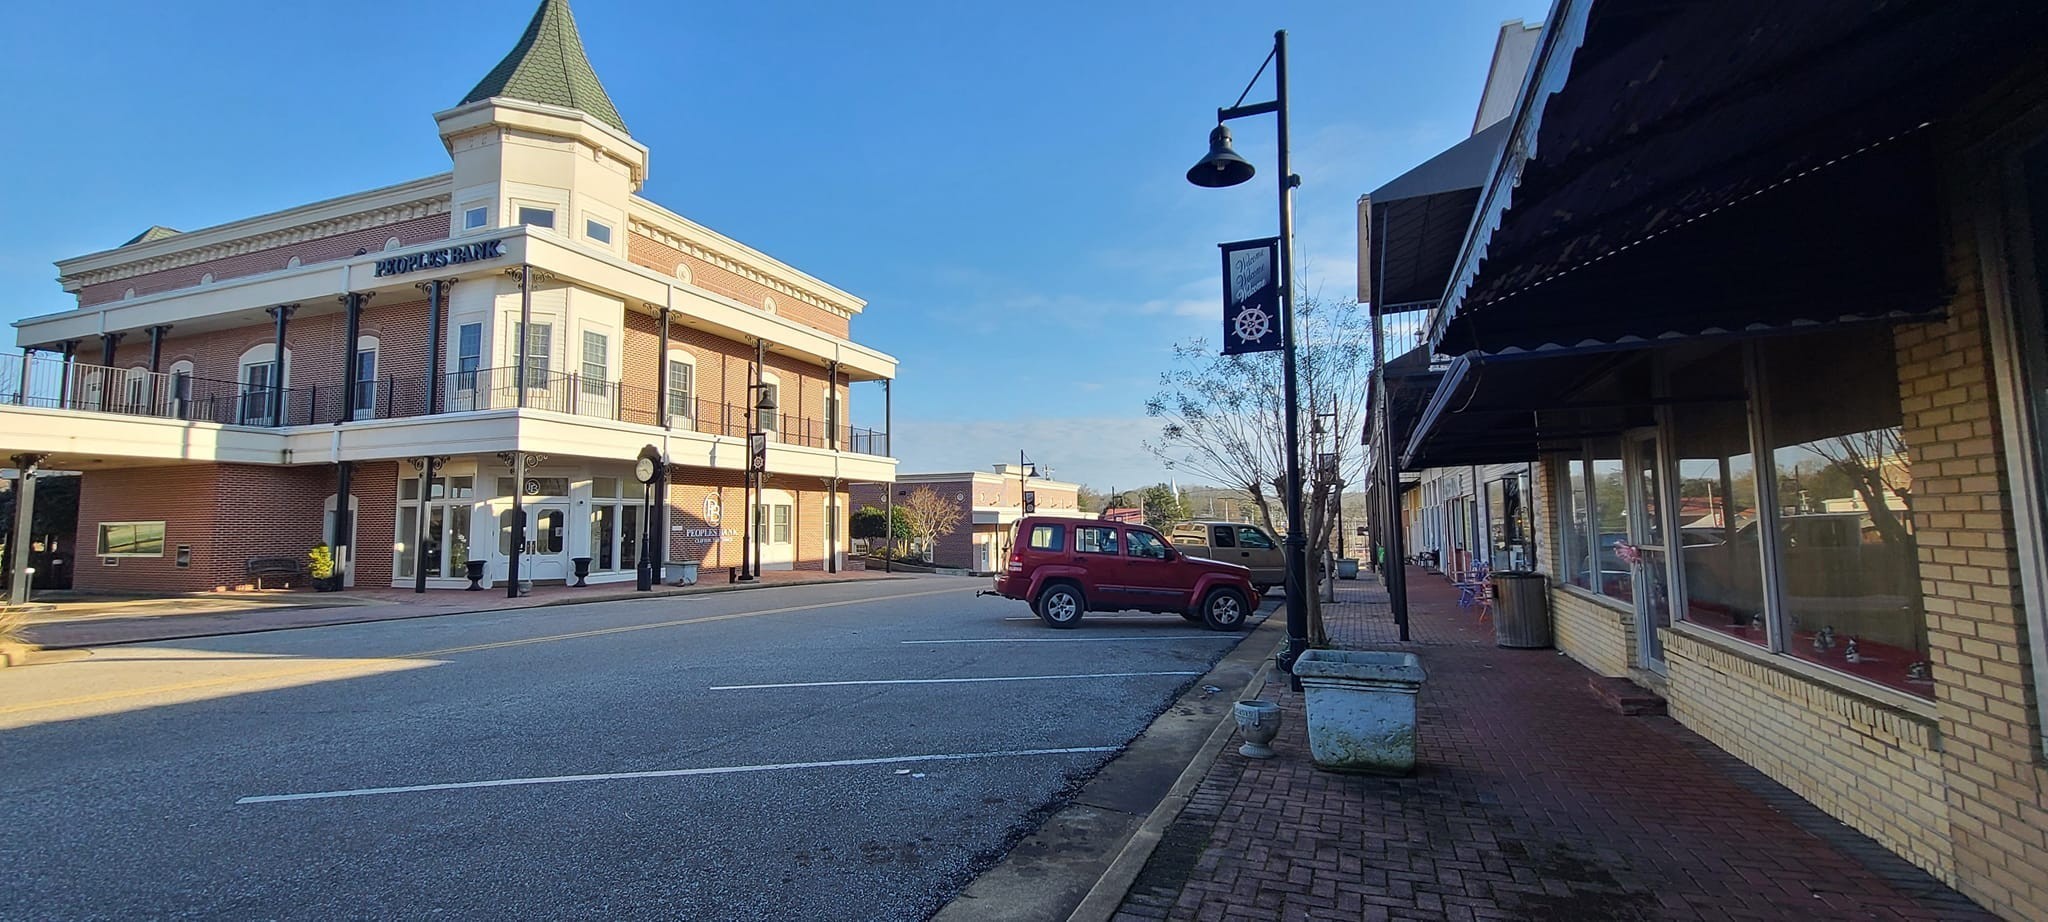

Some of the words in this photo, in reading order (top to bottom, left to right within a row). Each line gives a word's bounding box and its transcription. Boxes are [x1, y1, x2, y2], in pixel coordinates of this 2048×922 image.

[449, 239, 502, 265] BANK
[1235, 249, 1264, 273] Welcome
[1235, 263, 1265, 288] Welcome
[1235, 279, 1266, 303] Welcome
